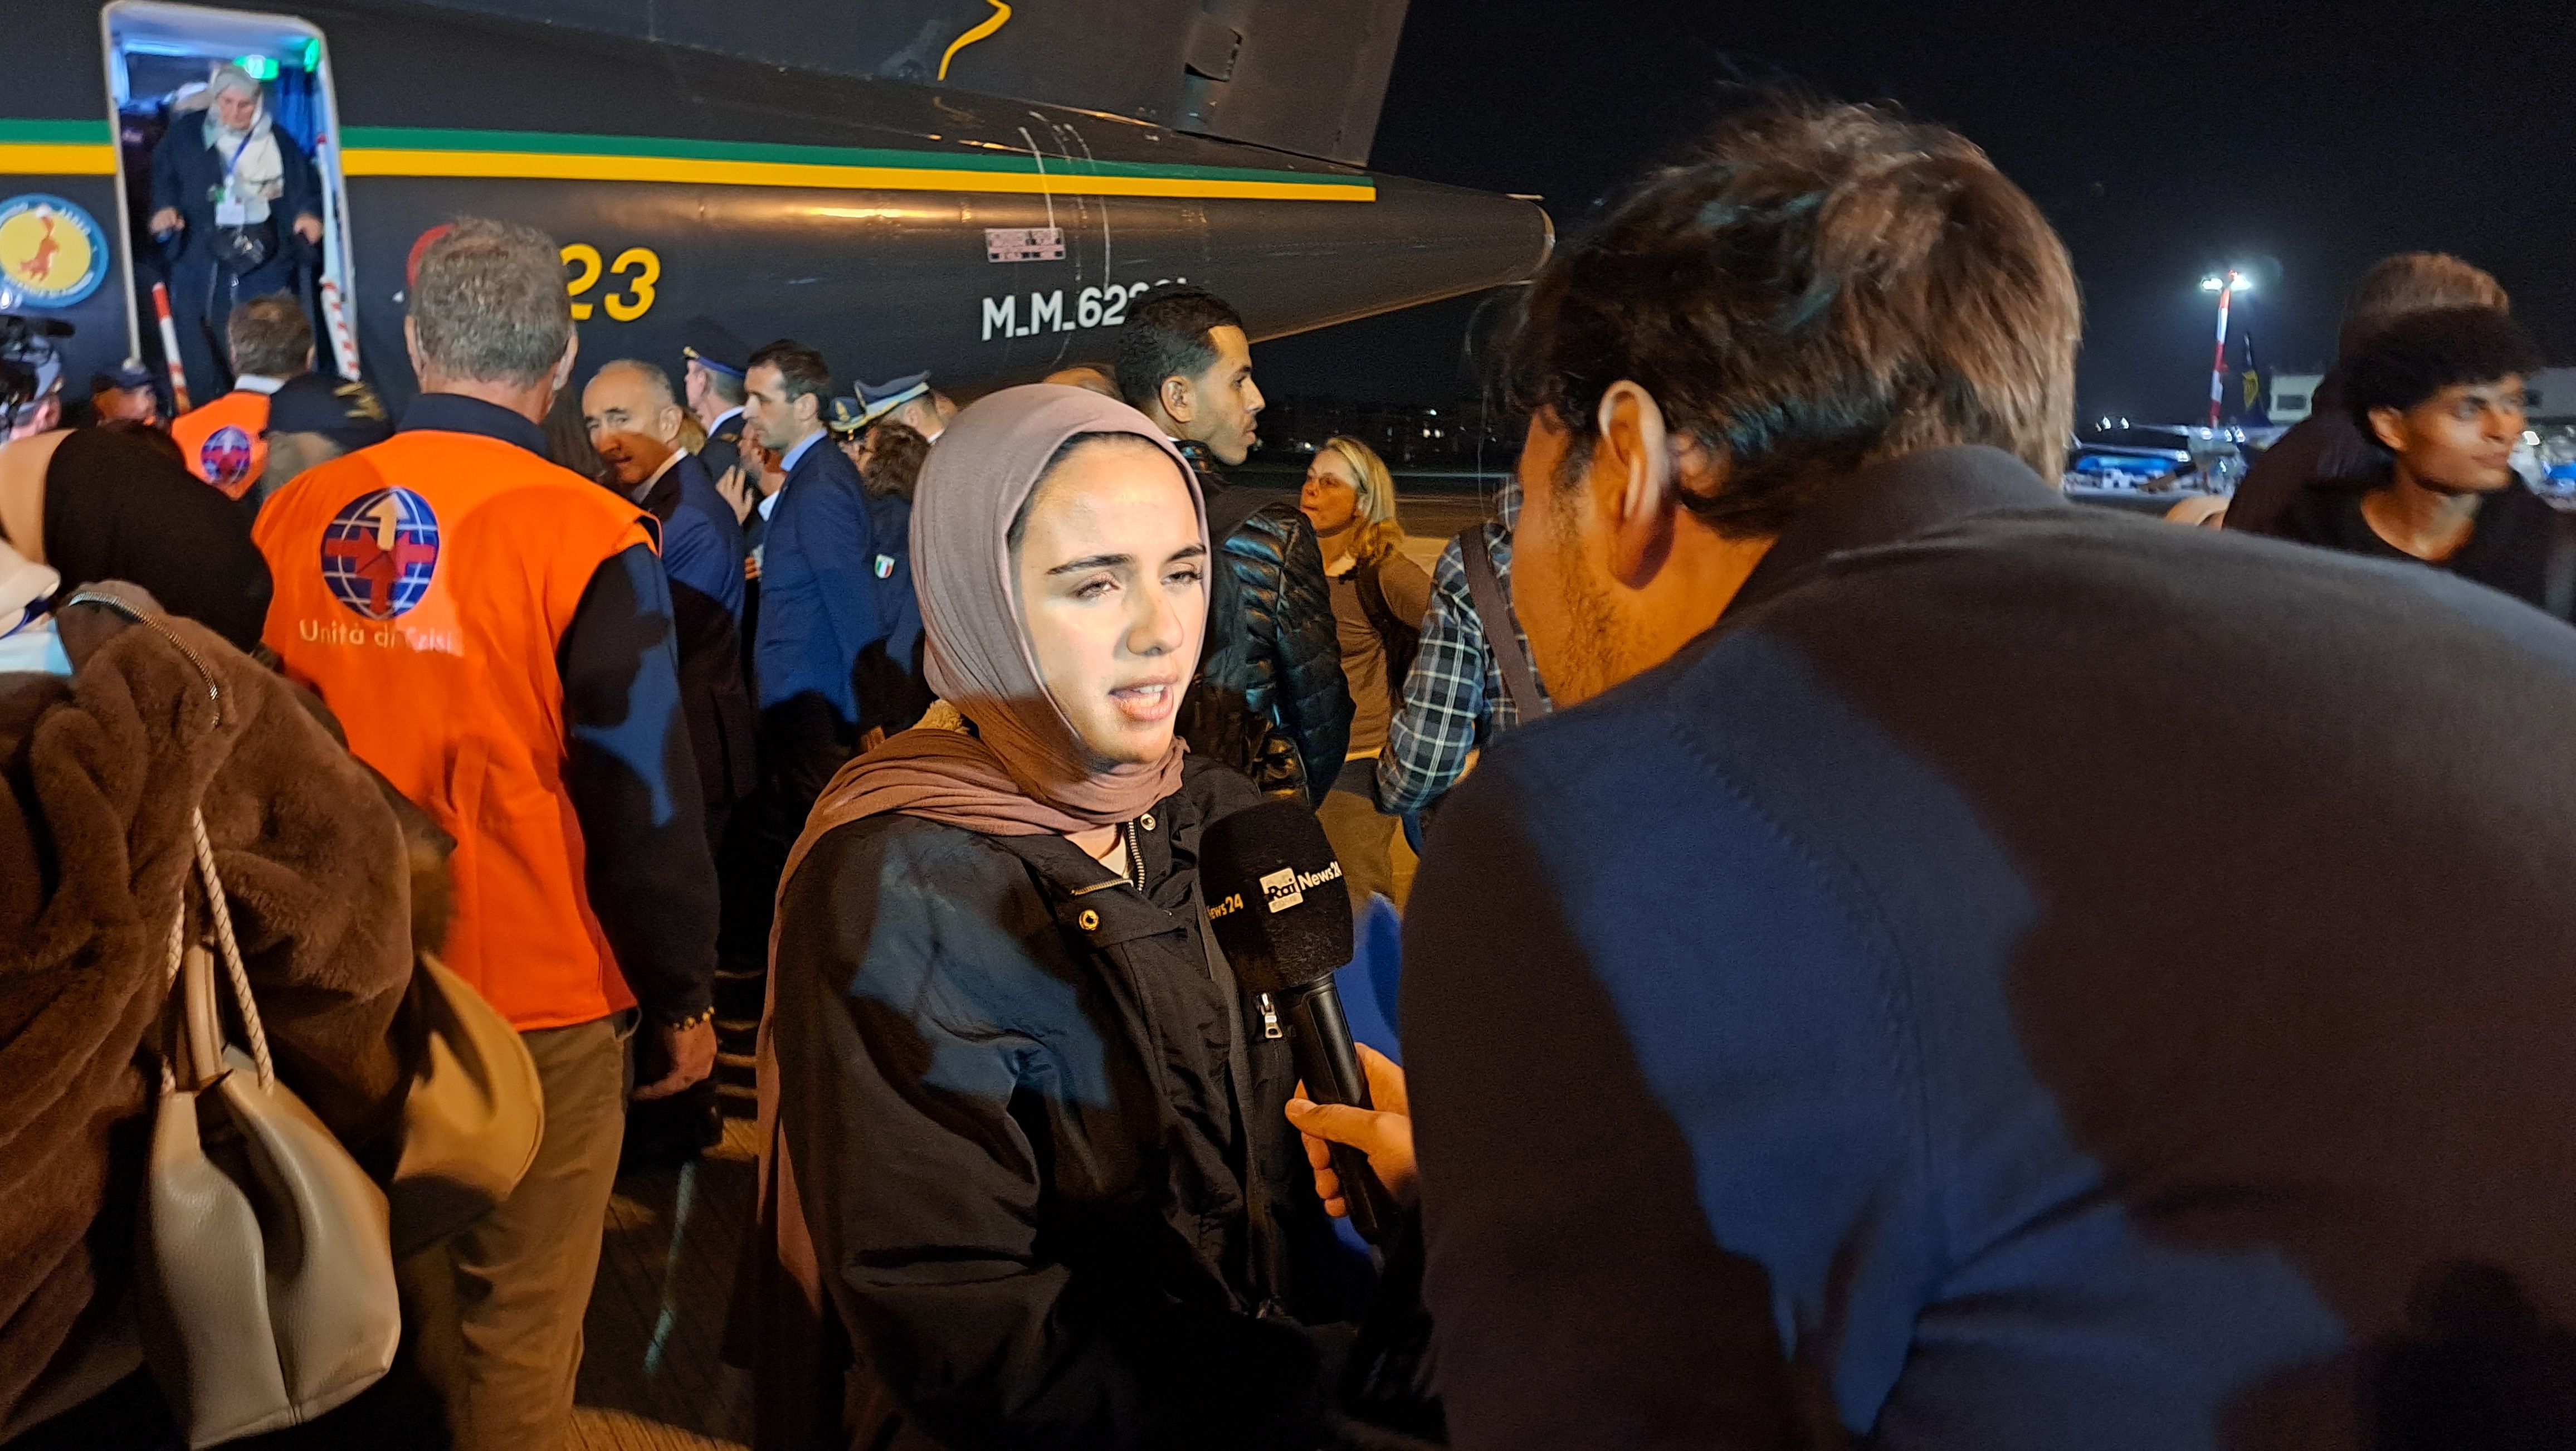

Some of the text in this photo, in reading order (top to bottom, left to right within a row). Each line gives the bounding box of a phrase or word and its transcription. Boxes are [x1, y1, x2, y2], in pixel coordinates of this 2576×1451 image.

[560, 243, 660, 322] 23
[981, 277, 1187, 342] M.M.62
[299, 619, 364, 645] Unità
[374, 624, 396, 649] di
